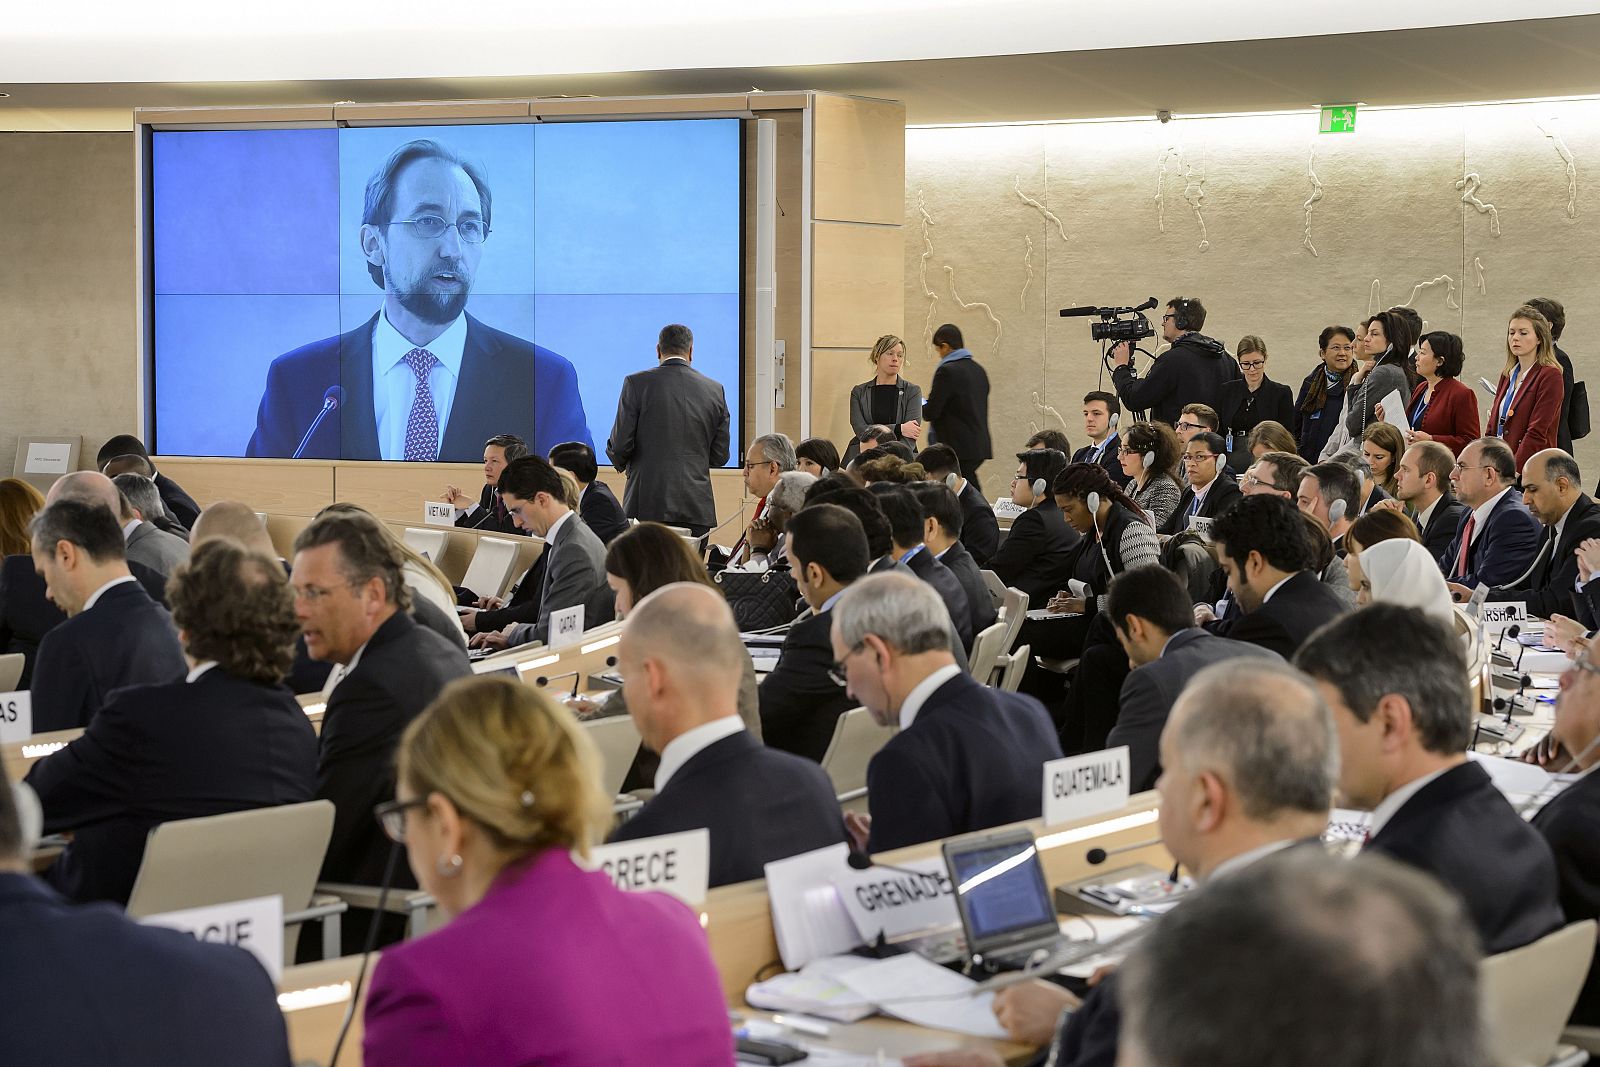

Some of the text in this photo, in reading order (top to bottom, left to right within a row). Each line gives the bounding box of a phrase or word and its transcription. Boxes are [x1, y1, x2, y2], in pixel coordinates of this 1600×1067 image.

[440, 507, 450, 518] NAM
[559, 614, 577, 634] QATAR
[1053, 760, 1123, 799] GUATEMALA
